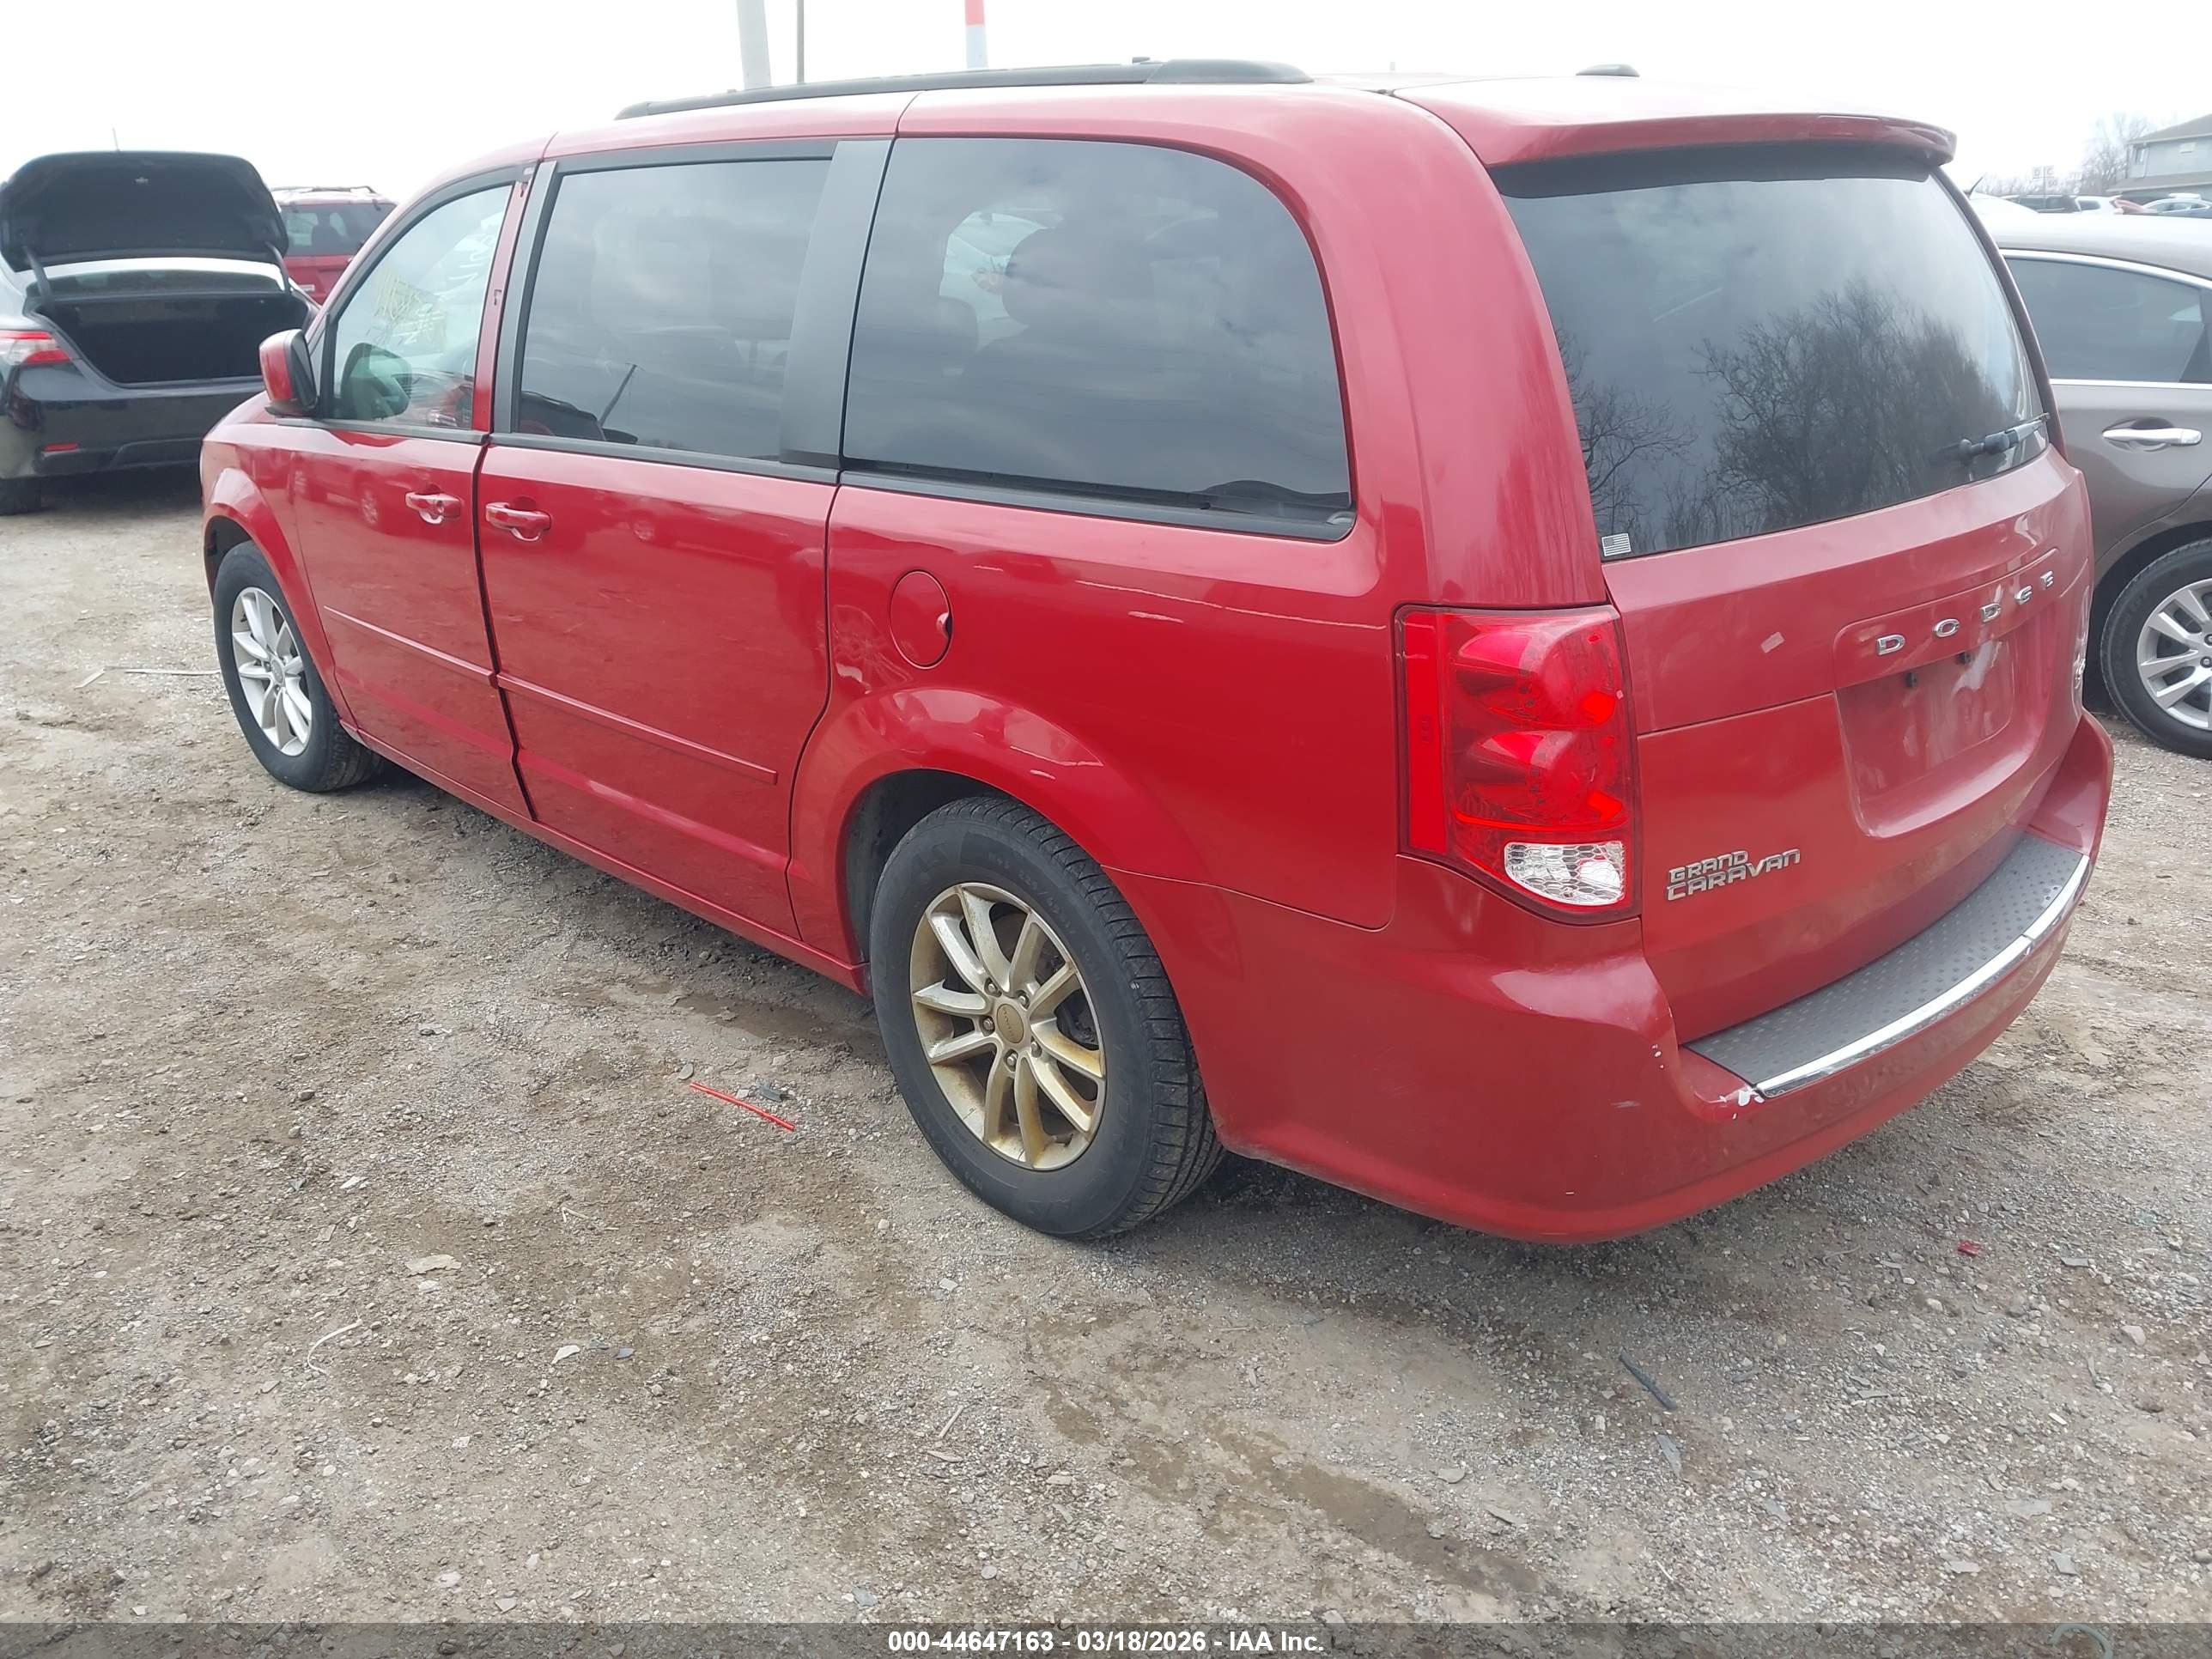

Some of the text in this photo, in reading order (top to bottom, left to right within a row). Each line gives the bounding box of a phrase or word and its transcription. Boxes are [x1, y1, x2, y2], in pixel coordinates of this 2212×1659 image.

[1876, 569, 2055, 656] DODGE
[1667, 848, 1801, 901] CARAVAN
[1668, 850, 1748, 883] GRAND
